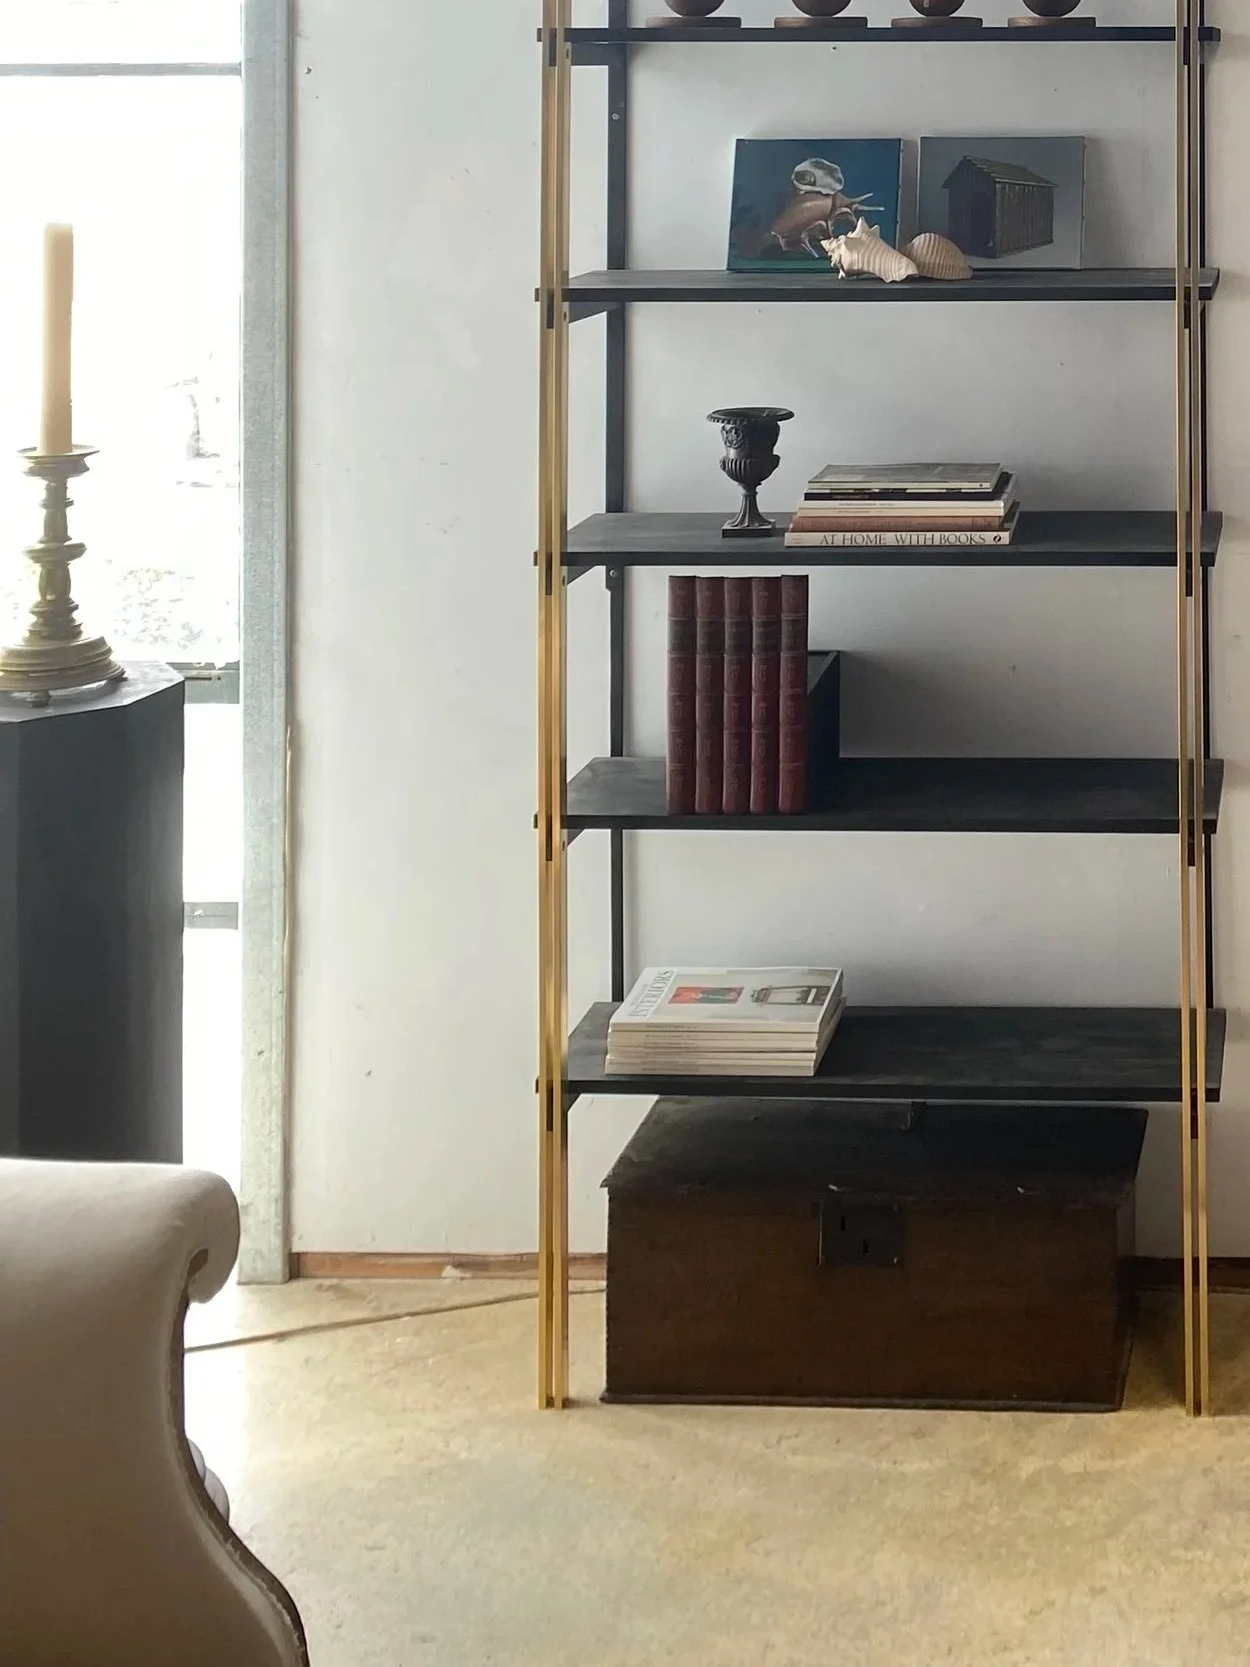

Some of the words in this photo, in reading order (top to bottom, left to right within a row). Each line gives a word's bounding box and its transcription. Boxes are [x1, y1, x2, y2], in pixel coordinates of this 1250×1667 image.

[820, 533, 838, 545] AT
[842, 533, 887, 545] HOME
[894, 533, 935, 545] WITH
[939, 533, 986, 545] BOOKS
